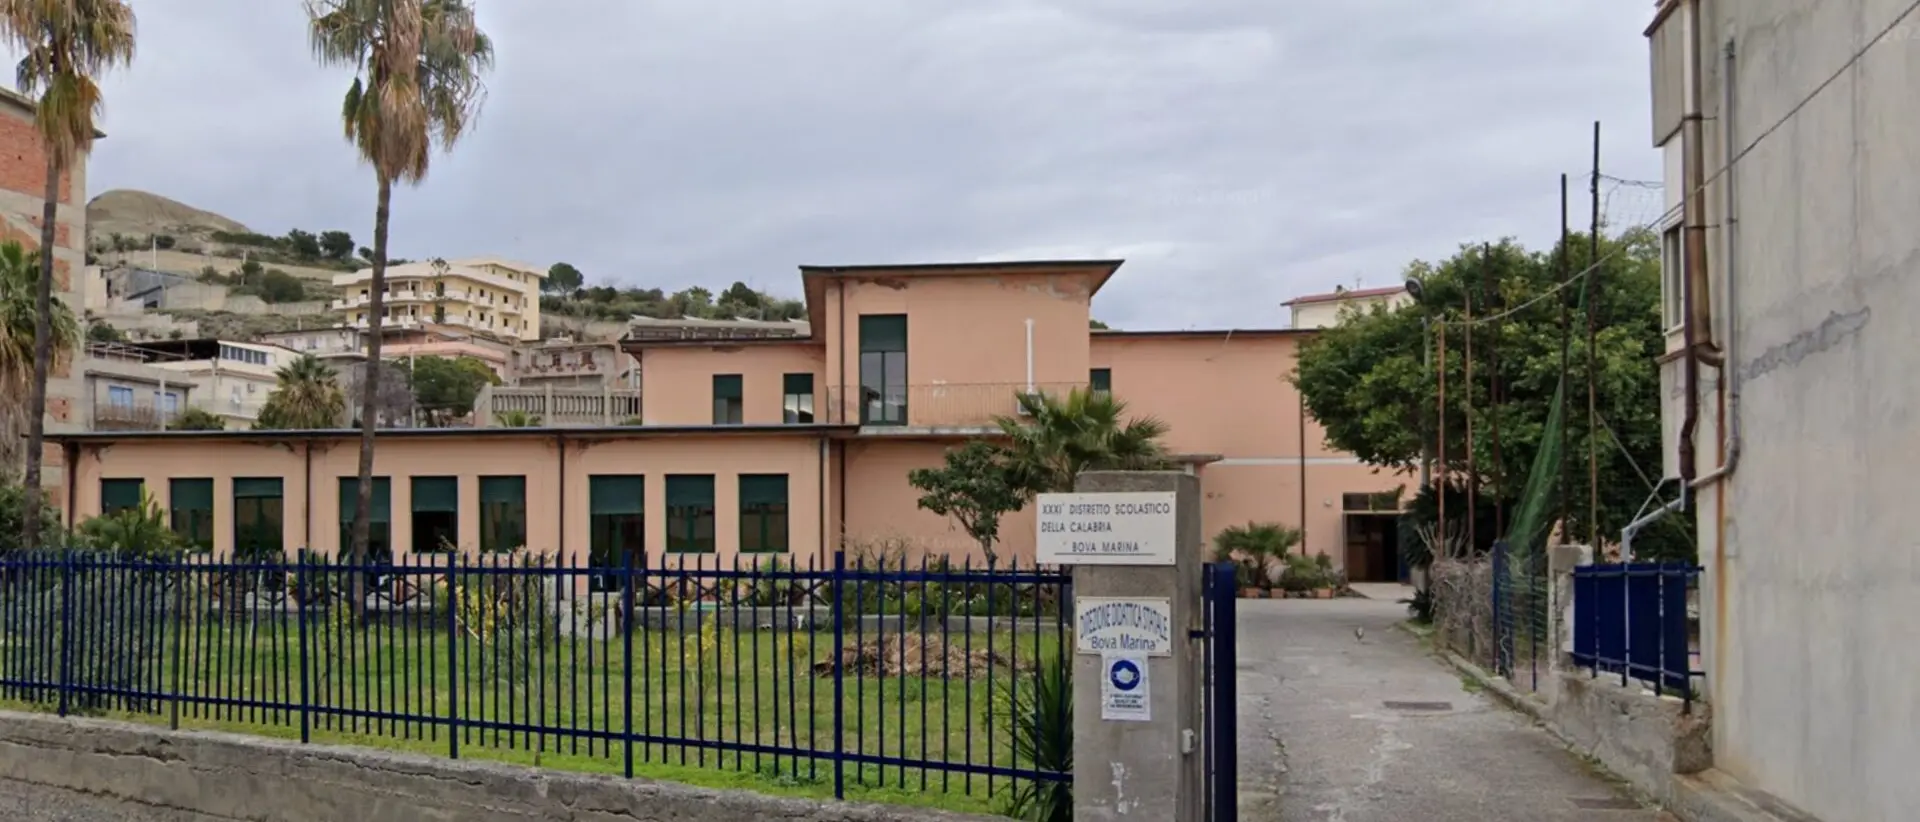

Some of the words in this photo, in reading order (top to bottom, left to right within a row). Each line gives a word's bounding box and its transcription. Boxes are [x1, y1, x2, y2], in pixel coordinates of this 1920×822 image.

[1069, 503, 1111, 515] DISTRETTO
[1115, 502, 1170, 515] SCOLASTICO
[1041, 521, 1065, 533] DELLA
[1070, 521, 1112, 533] CALABRIA
[1072, 541, 1097, 553] BOVA
[1102, 541, 1139, 553] MARINA
[1080, 604, 1111, 639] DIREZIONE
[1111, 602, 1142, 628] DIDATTICA
[1143, 606, 1168, 641] STATALE
